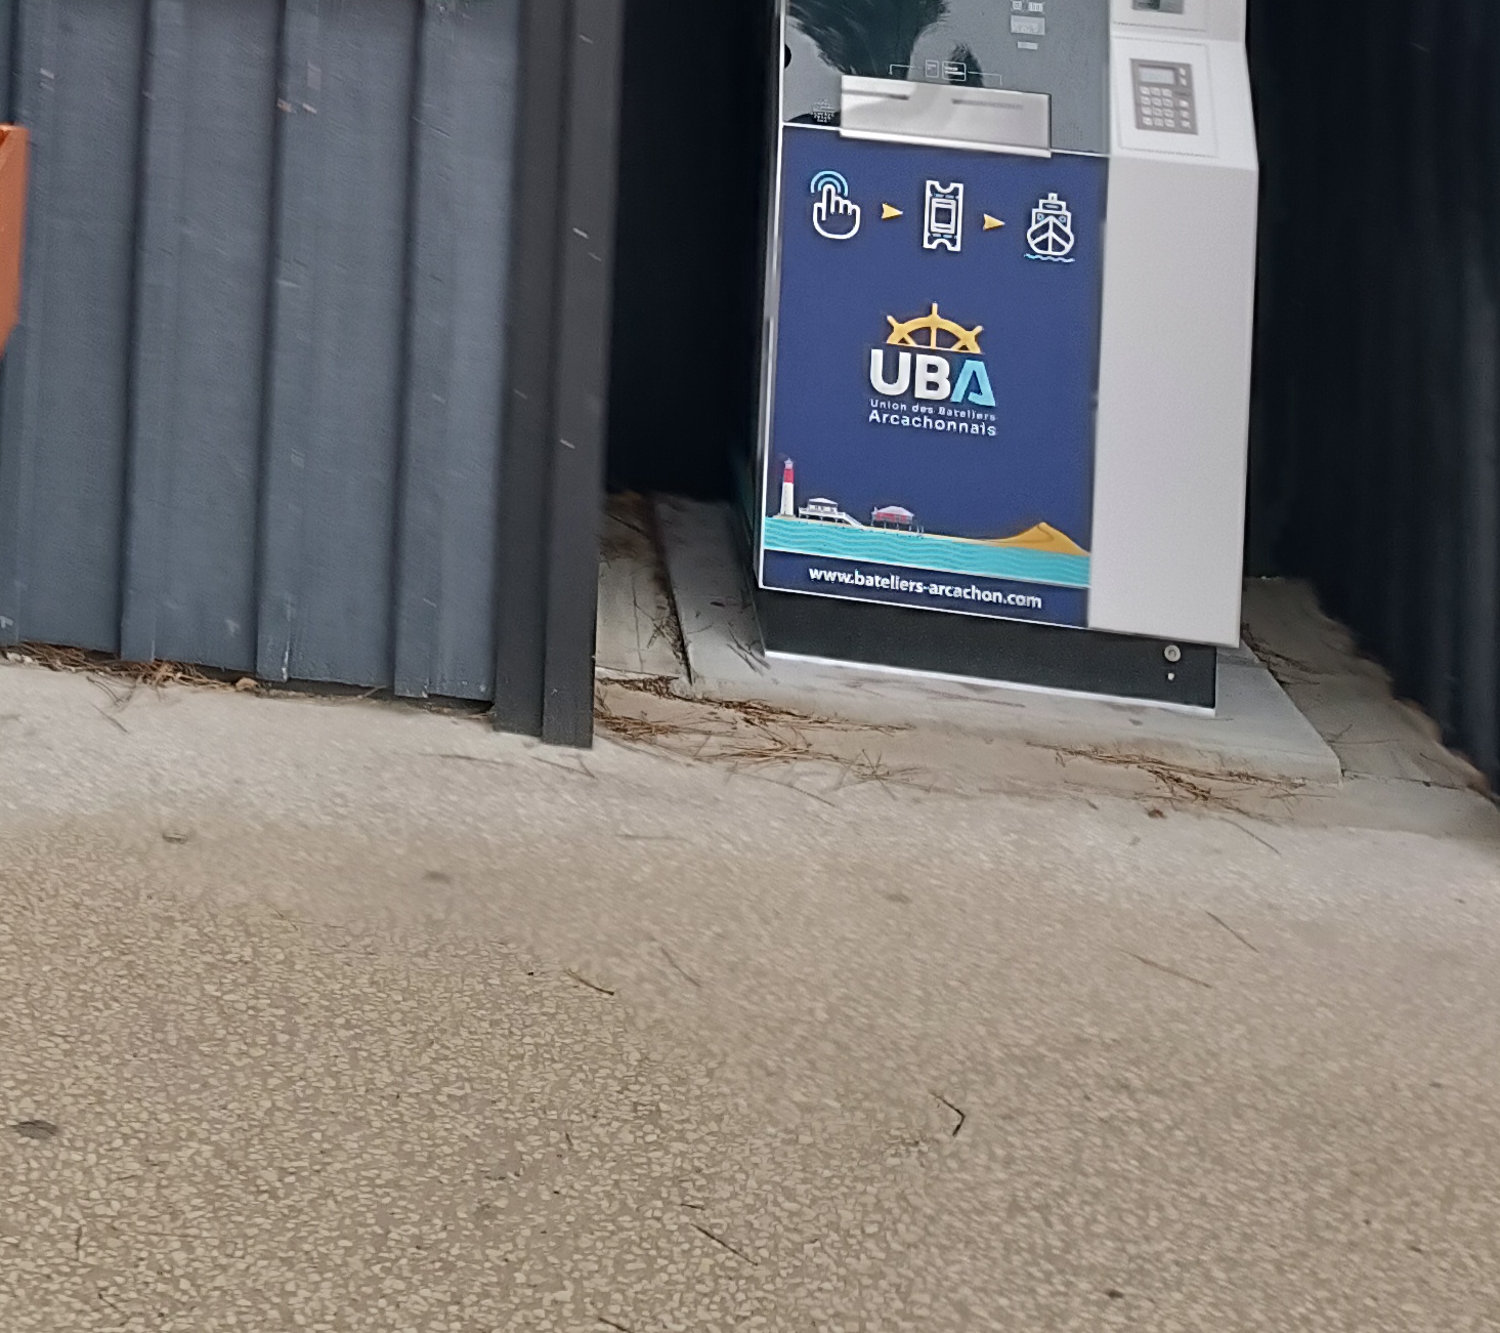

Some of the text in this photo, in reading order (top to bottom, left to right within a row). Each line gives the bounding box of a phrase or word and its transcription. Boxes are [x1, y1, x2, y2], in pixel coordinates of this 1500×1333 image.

[869, 348, 996, 407] UBA
[868, 409, 998, 437] Arcachonnais
[869, 398, 997, 422] Union des Bateliers
[808, 568, 1043, 609] www.bateliers-arcachon.com
